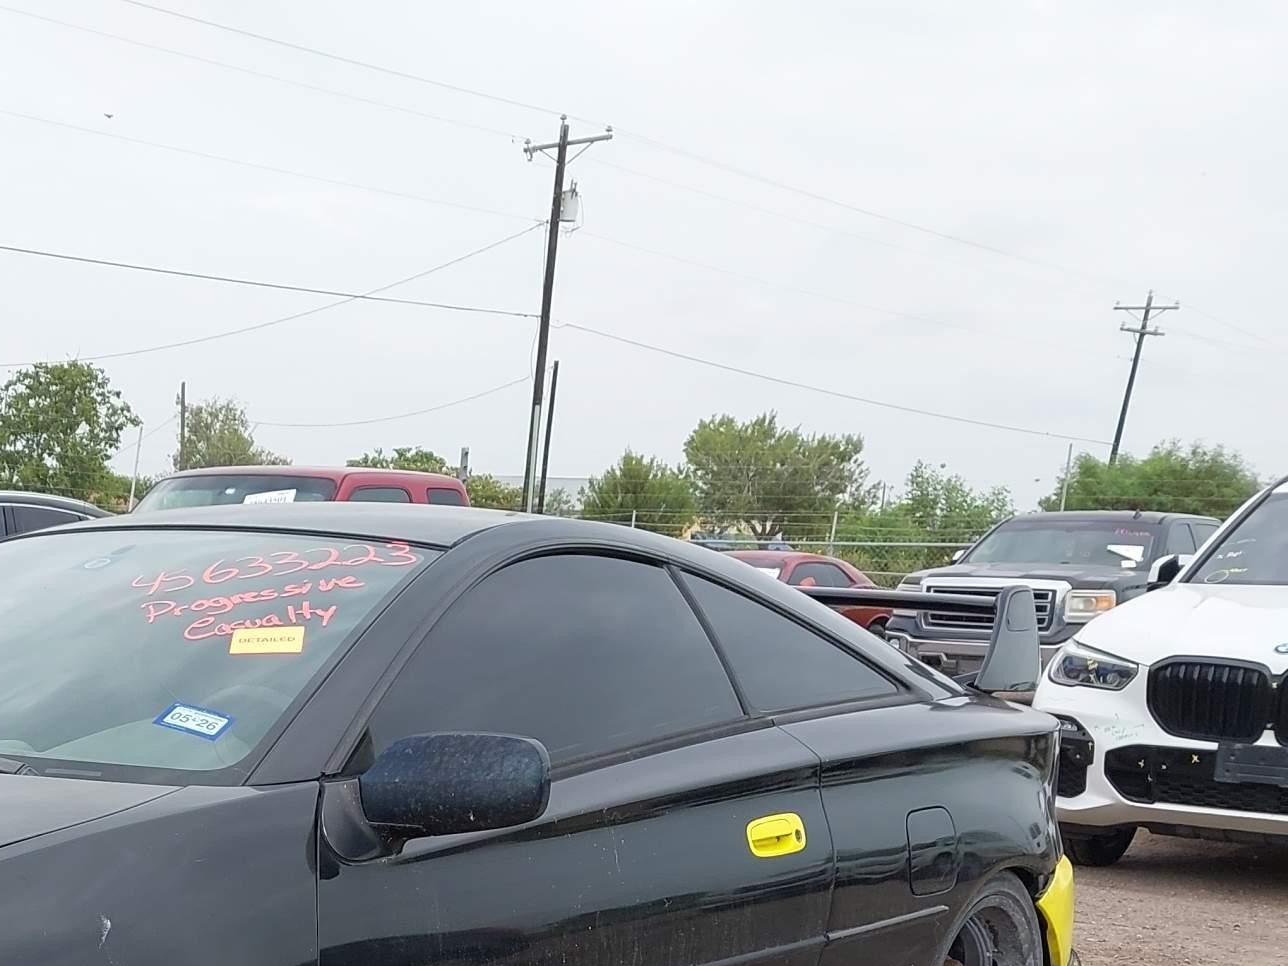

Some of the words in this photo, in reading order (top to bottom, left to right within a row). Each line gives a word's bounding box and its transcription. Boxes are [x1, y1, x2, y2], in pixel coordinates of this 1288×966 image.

[141, 575, 365, 623] Progressive
[183, 601, 337, 640] Casualty
[238, 635, 297, 644] DETAILED
